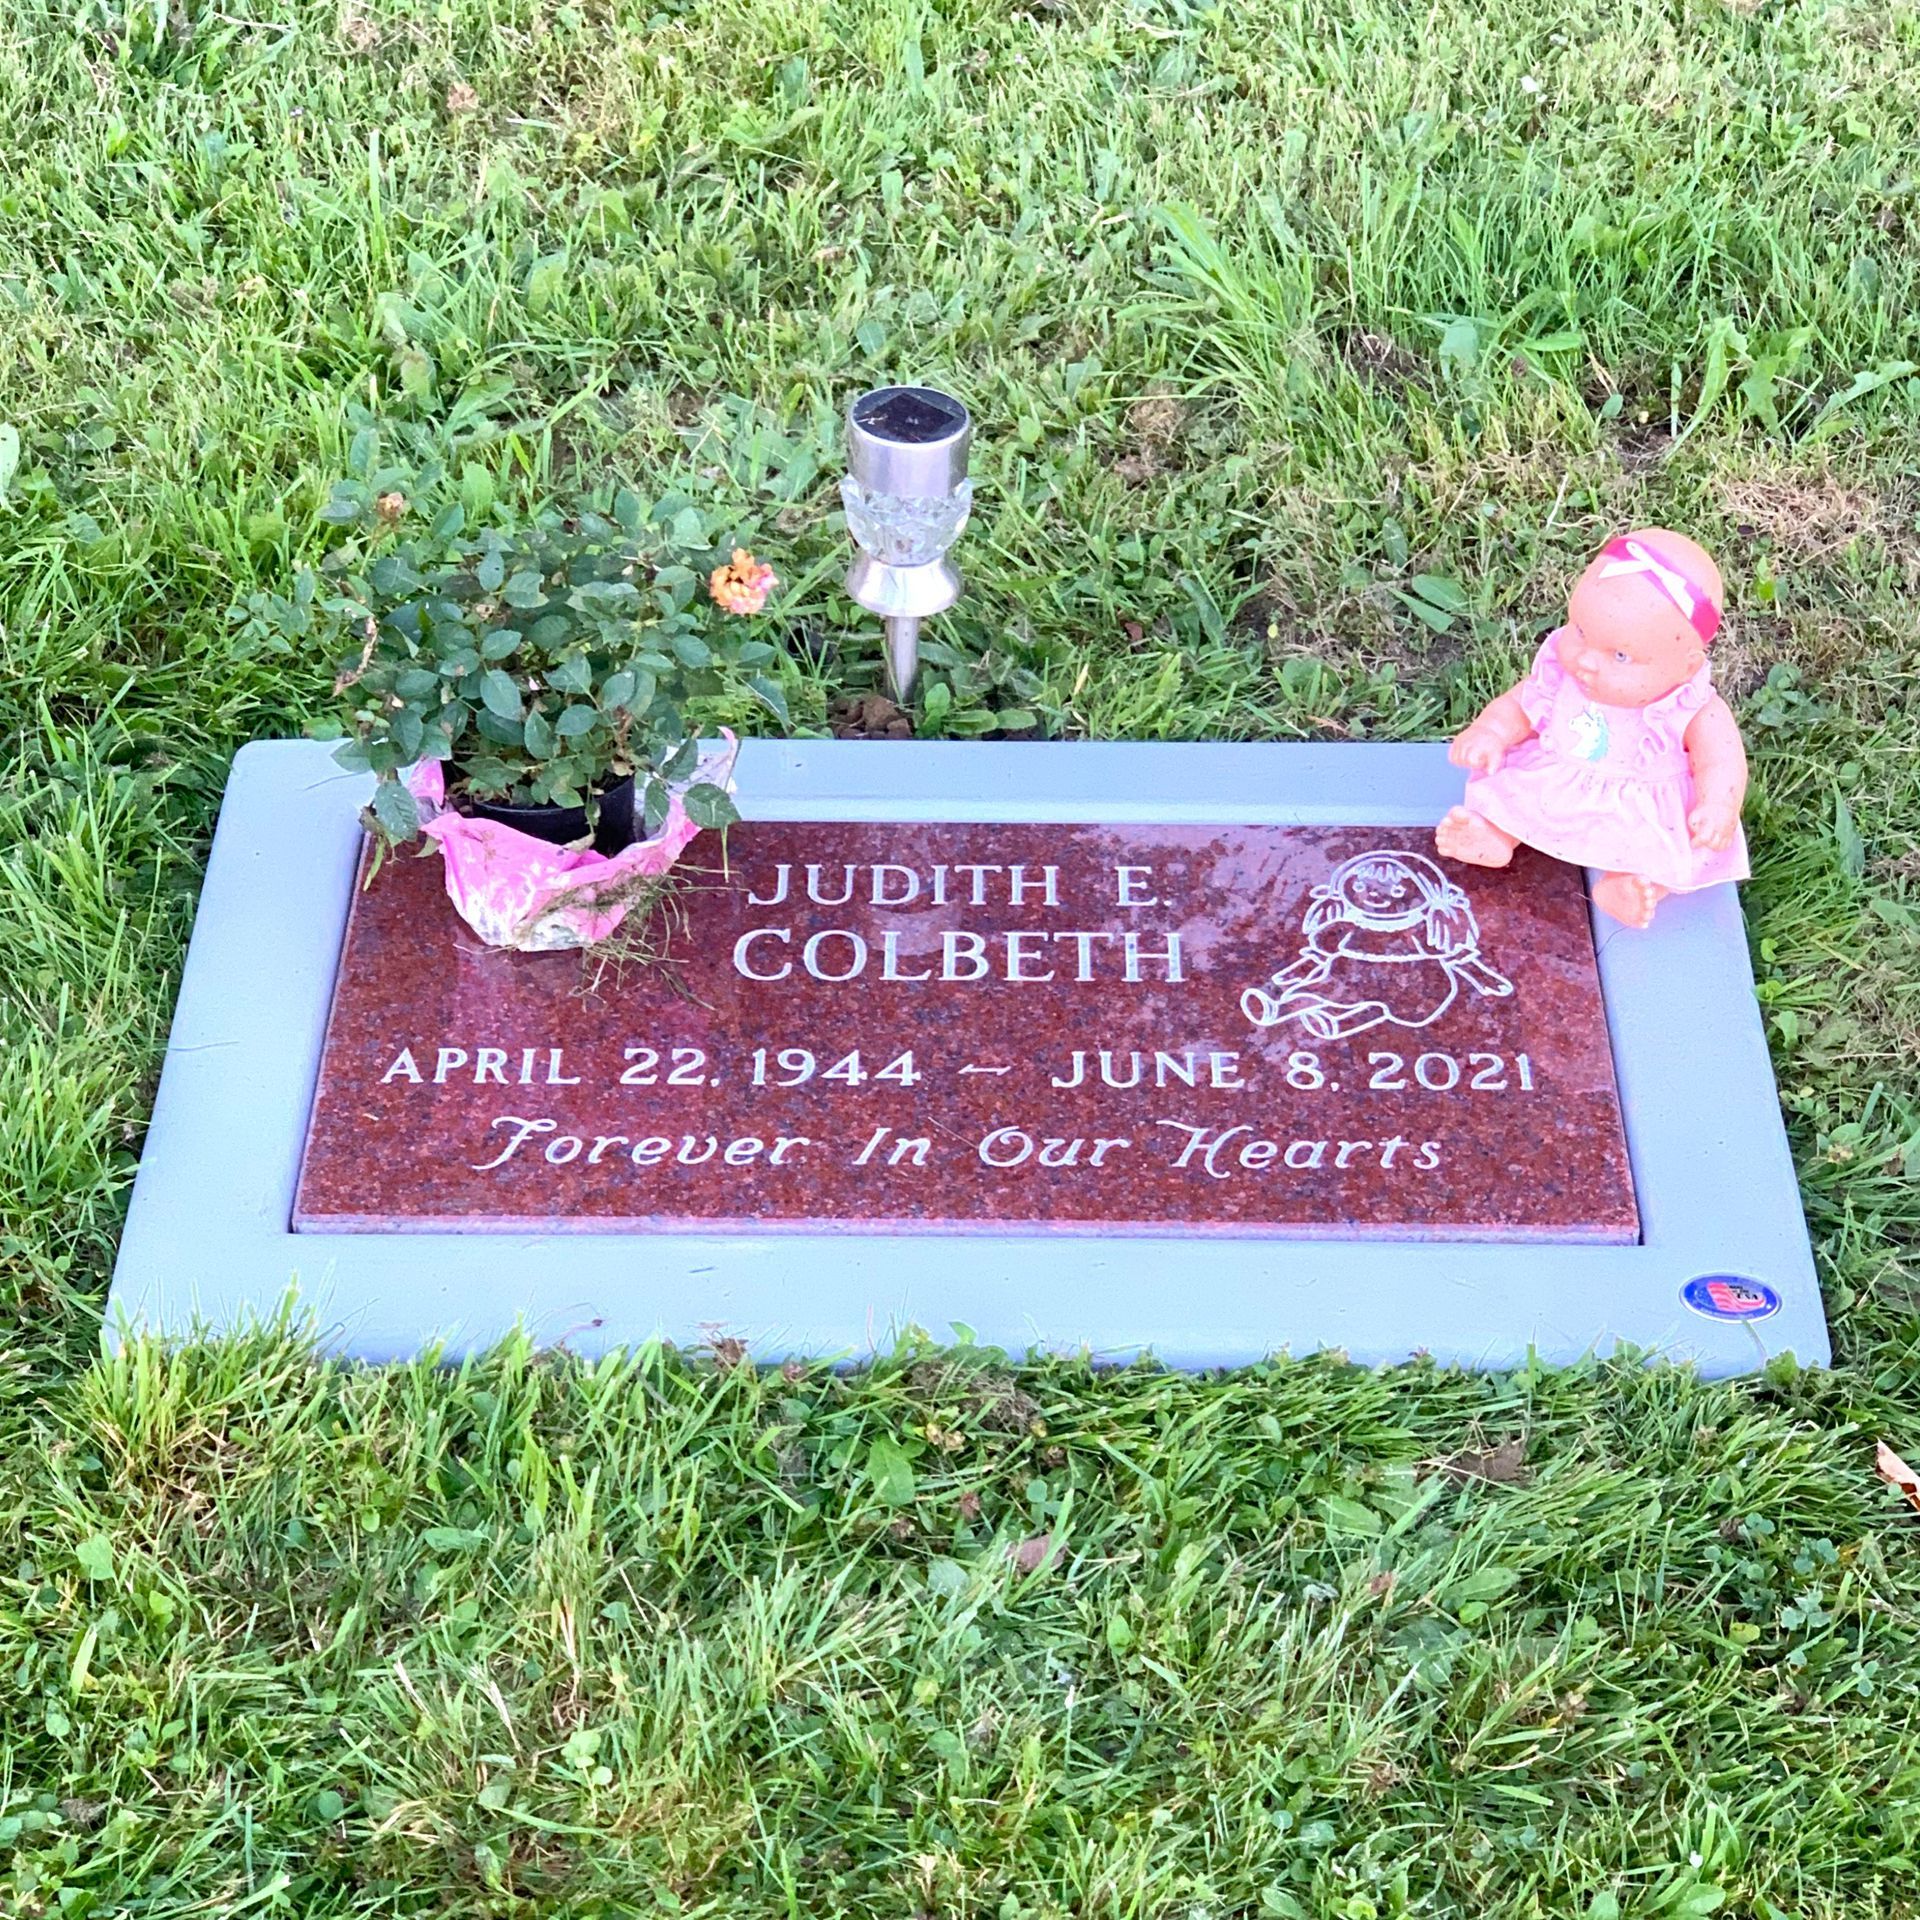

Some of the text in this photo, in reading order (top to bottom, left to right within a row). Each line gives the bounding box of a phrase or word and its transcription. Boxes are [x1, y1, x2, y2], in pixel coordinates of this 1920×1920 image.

[748, 864, 1173, 907] JUDITH E.
[732, 928, 1188, 983] COLBETH
[380, 1047, 582, 1085] APRIL
[751, 1048, 922, 1087] 1944
[1051, 1051, 1246, 1089] JUNE
[1367, 1052, 1535, 1091] 2021
[471, 1116, 1442, 1179] Forever In Our Hearts
